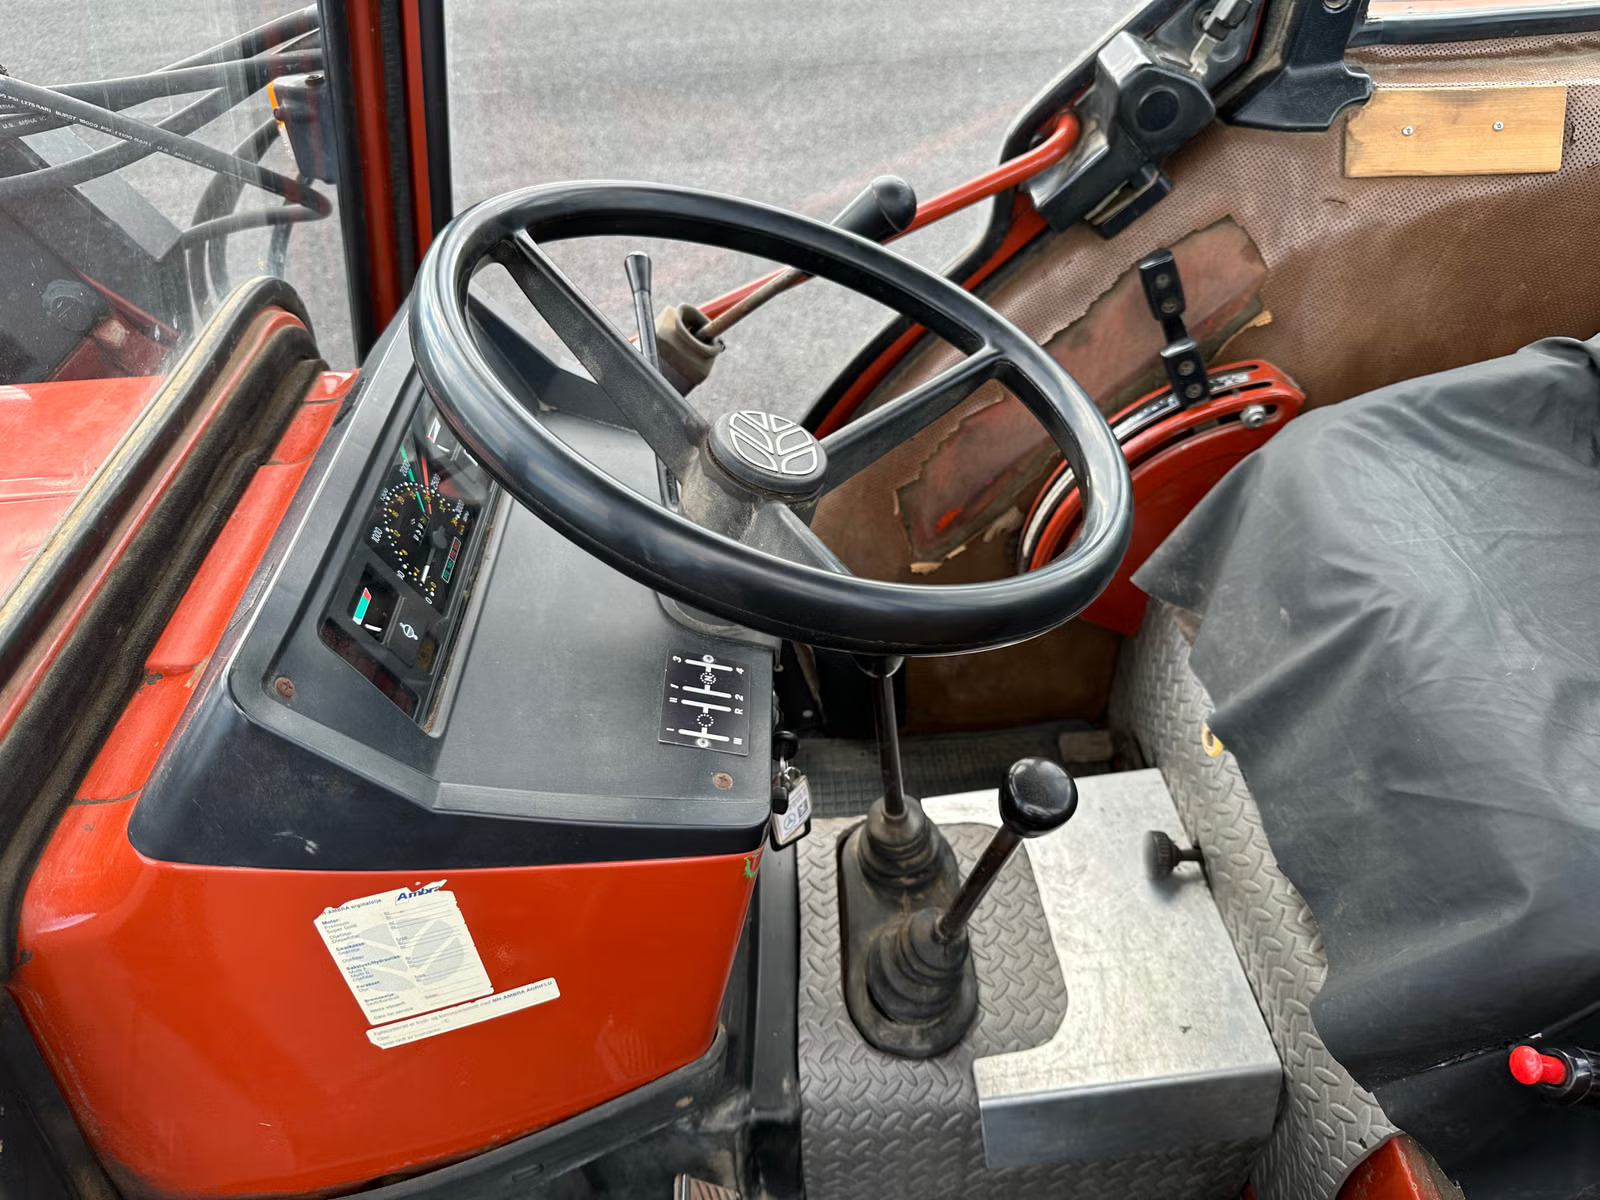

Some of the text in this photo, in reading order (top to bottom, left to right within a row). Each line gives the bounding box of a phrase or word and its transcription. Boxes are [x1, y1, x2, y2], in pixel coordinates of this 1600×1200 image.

[56, 110, 77, 120] BURST
[400, 459, 411, 477] 2000
[430, 473, 441, 491] 2500
[371, 526, 383, 544] 1000
[425, 596, 433, 605] 0
[672, 655, 682, 663] 3
[736, 667, 745, 675] 4
[735, 694, 744, 702] 2
